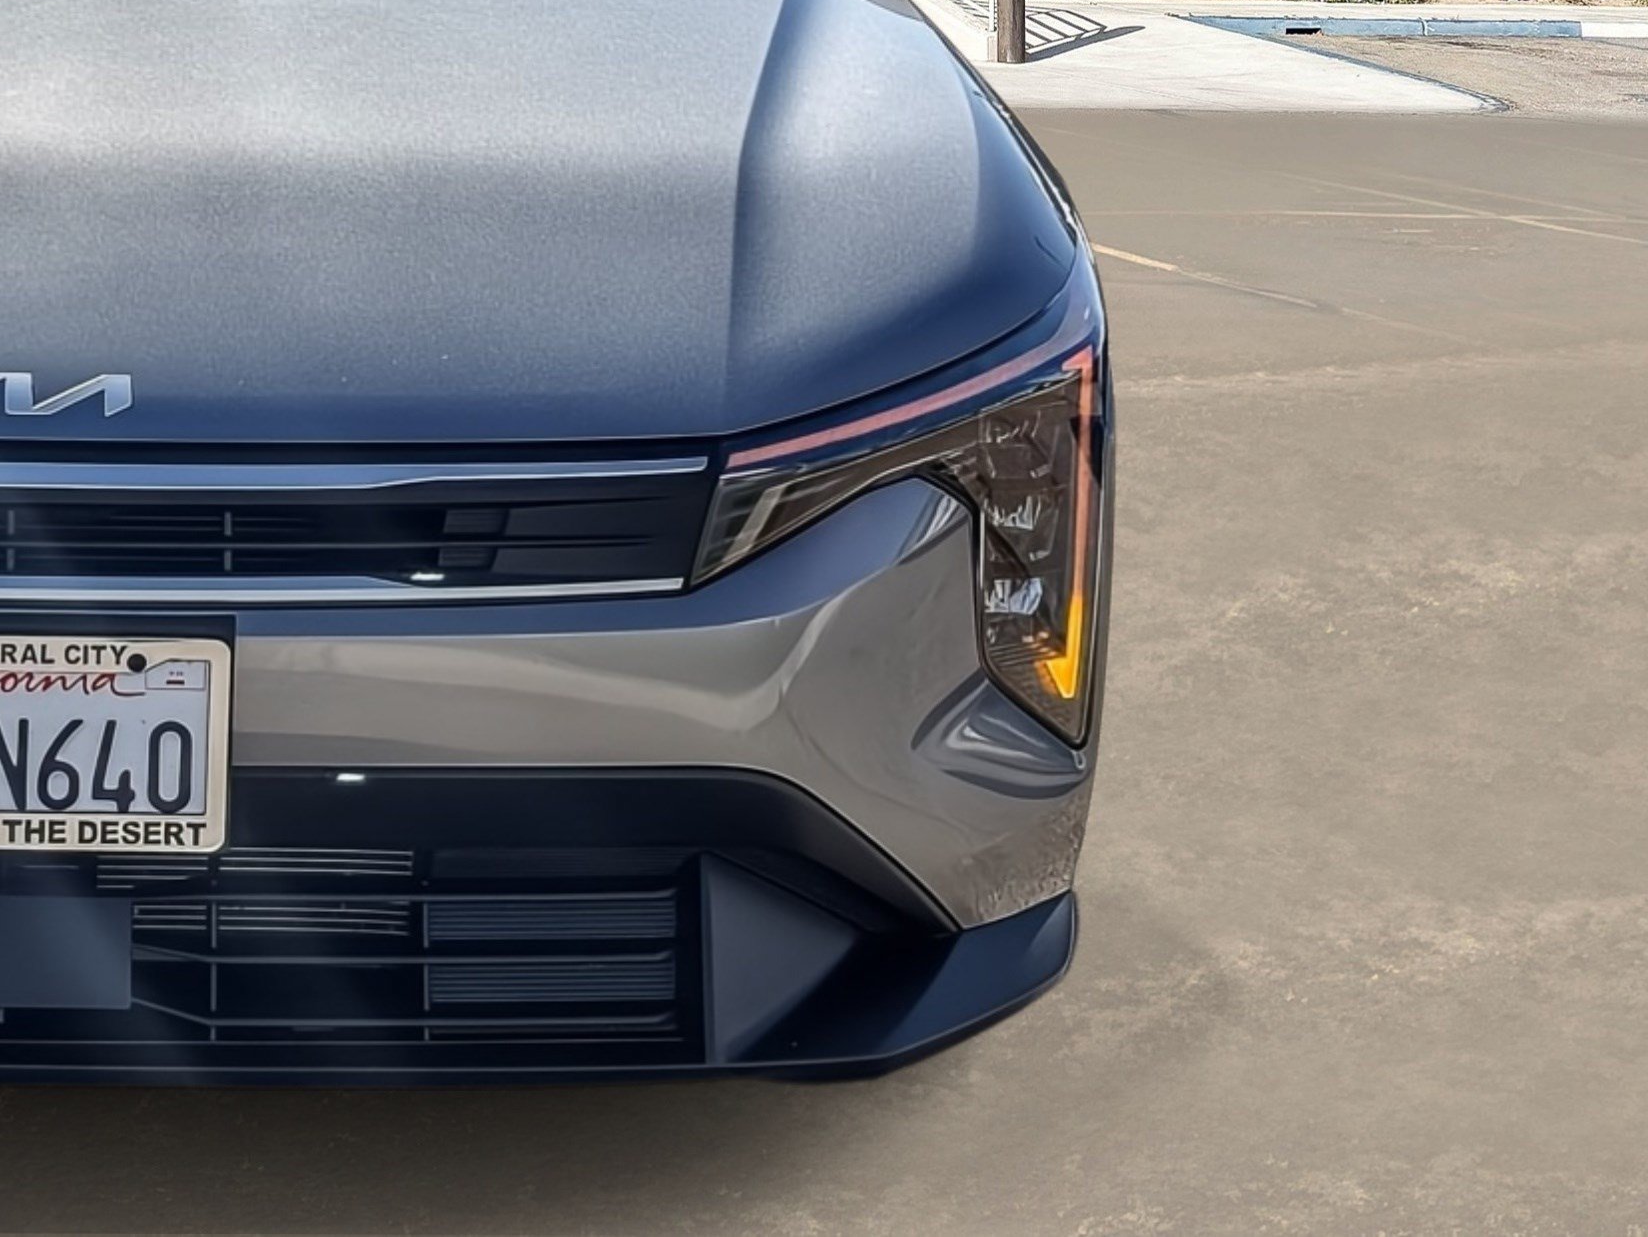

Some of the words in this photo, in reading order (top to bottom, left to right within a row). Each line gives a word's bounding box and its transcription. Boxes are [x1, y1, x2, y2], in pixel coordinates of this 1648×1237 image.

[64, 645, 127, 666] CITY
[3, 819, 68, 844] THE
[78, 820, 207, 846] DESERT
